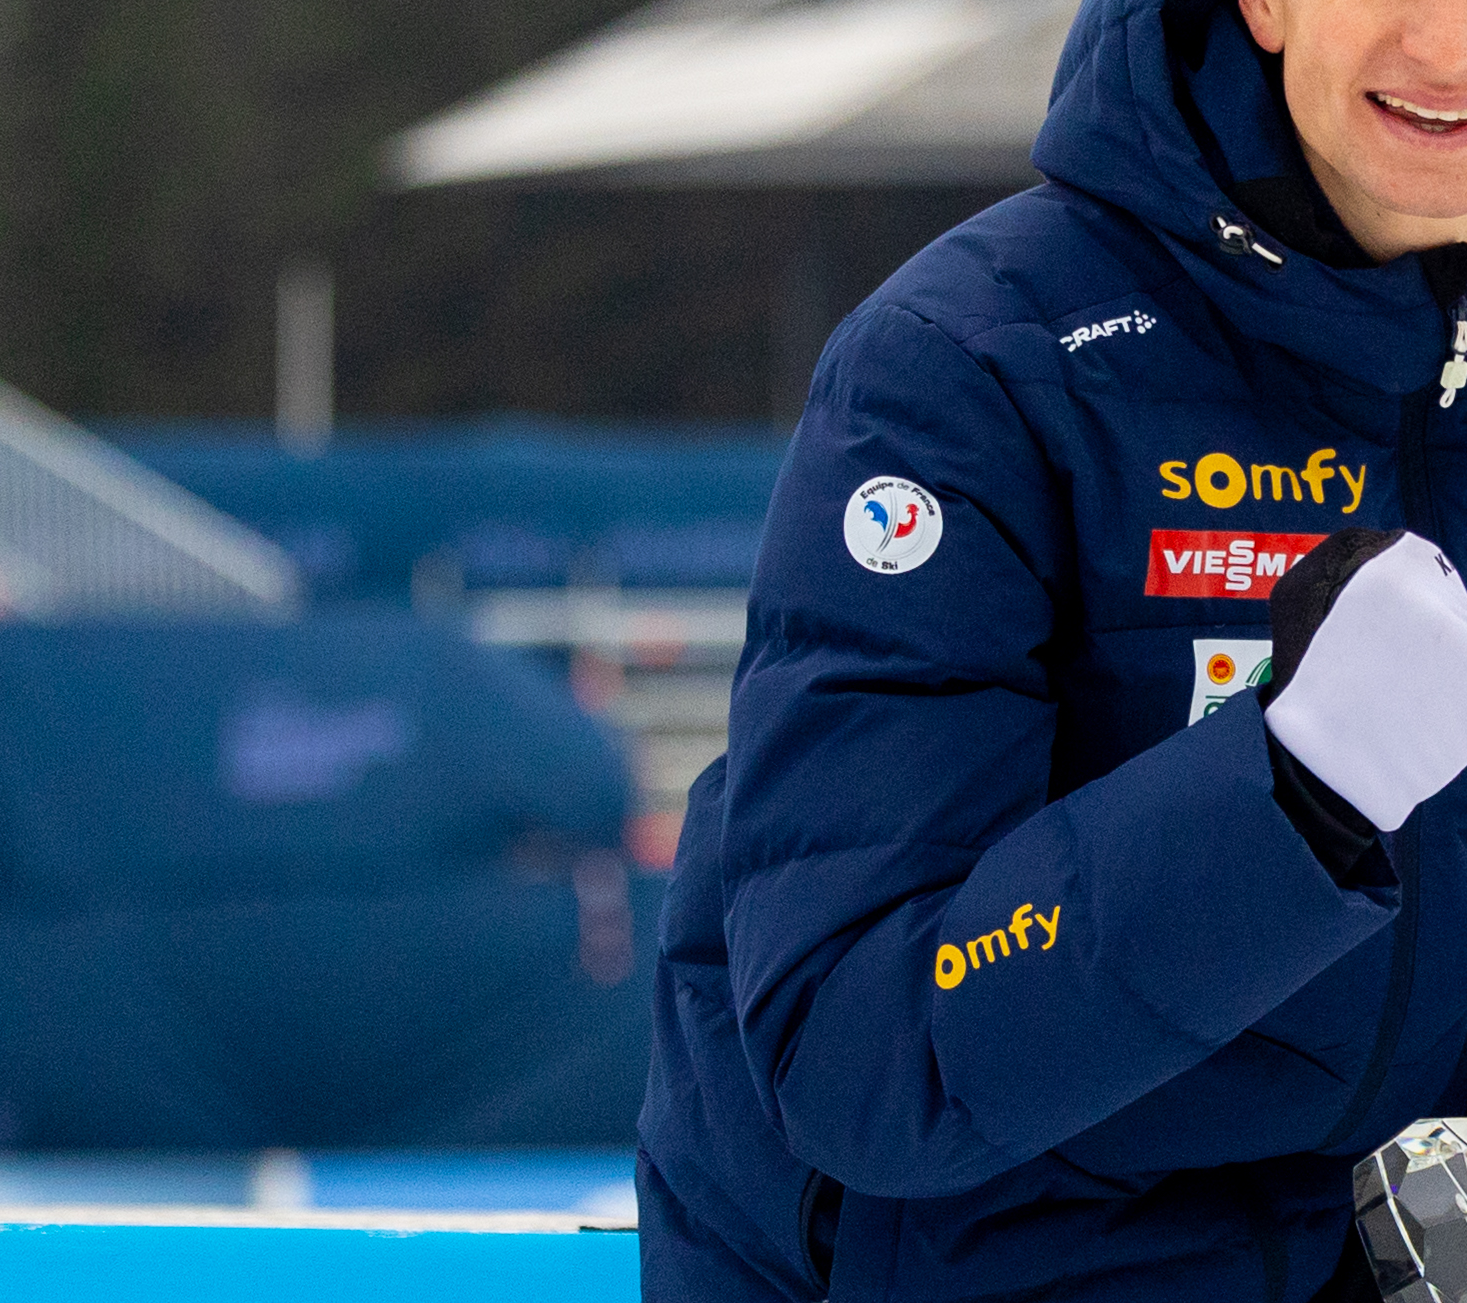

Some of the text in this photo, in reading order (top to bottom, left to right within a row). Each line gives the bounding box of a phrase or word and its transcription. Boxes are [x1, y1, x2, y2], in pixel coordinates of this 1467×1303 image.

[1060, 315, 1133, 352] CRAFT
[859, 481, 895, 500] Equipe
[911, 487, 936, 517] France
[1159, 448, 1366, 514] somfy
[881, 561, 899, 571] Ski
[1163, 539, 1306, 592] VIESSM
[935, 903, 1061, 990] omfy
